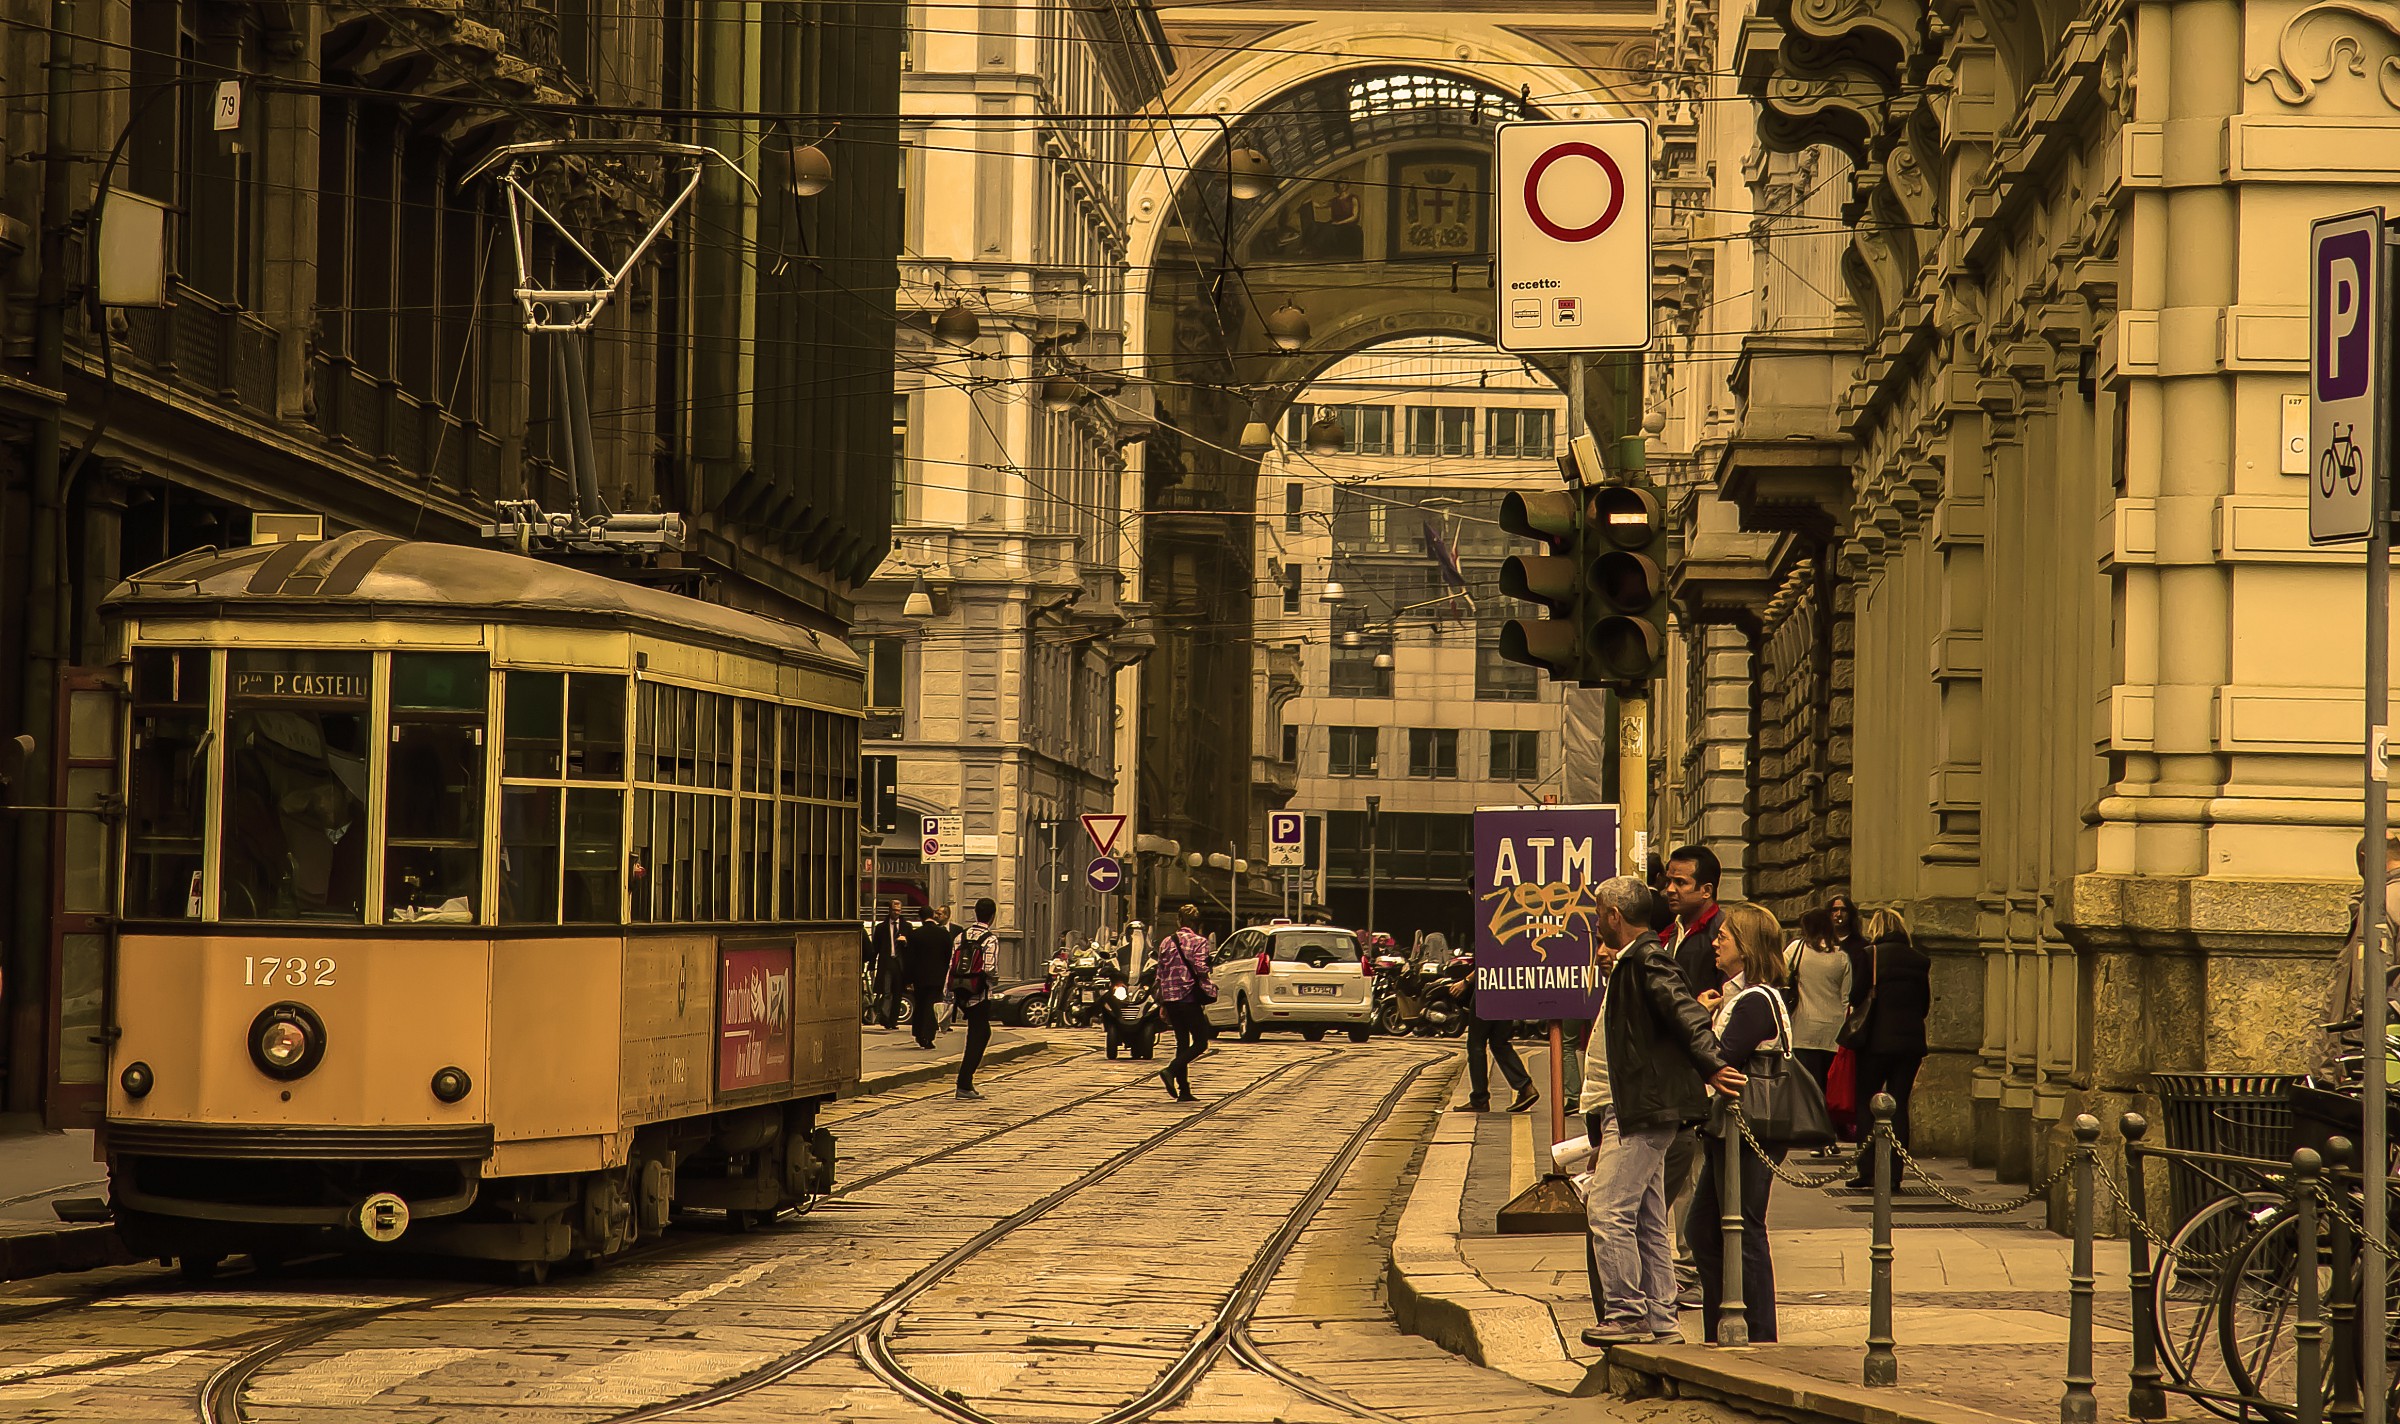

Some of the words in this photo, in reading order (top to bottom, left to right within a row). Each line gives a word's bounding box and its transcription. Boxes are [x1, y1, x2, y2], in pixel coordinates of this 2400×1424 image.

[221, 95, 235, 117] 79
[1511, 279, 1561, 290] eccetto:
[2329, 257, 2360, 379] P
[926, 820, 936, 833] P
[1278, 818, 1295, 840] P
[1525, 915, 1564, 939] FINE
[244, 955, 337, 987] 1732
